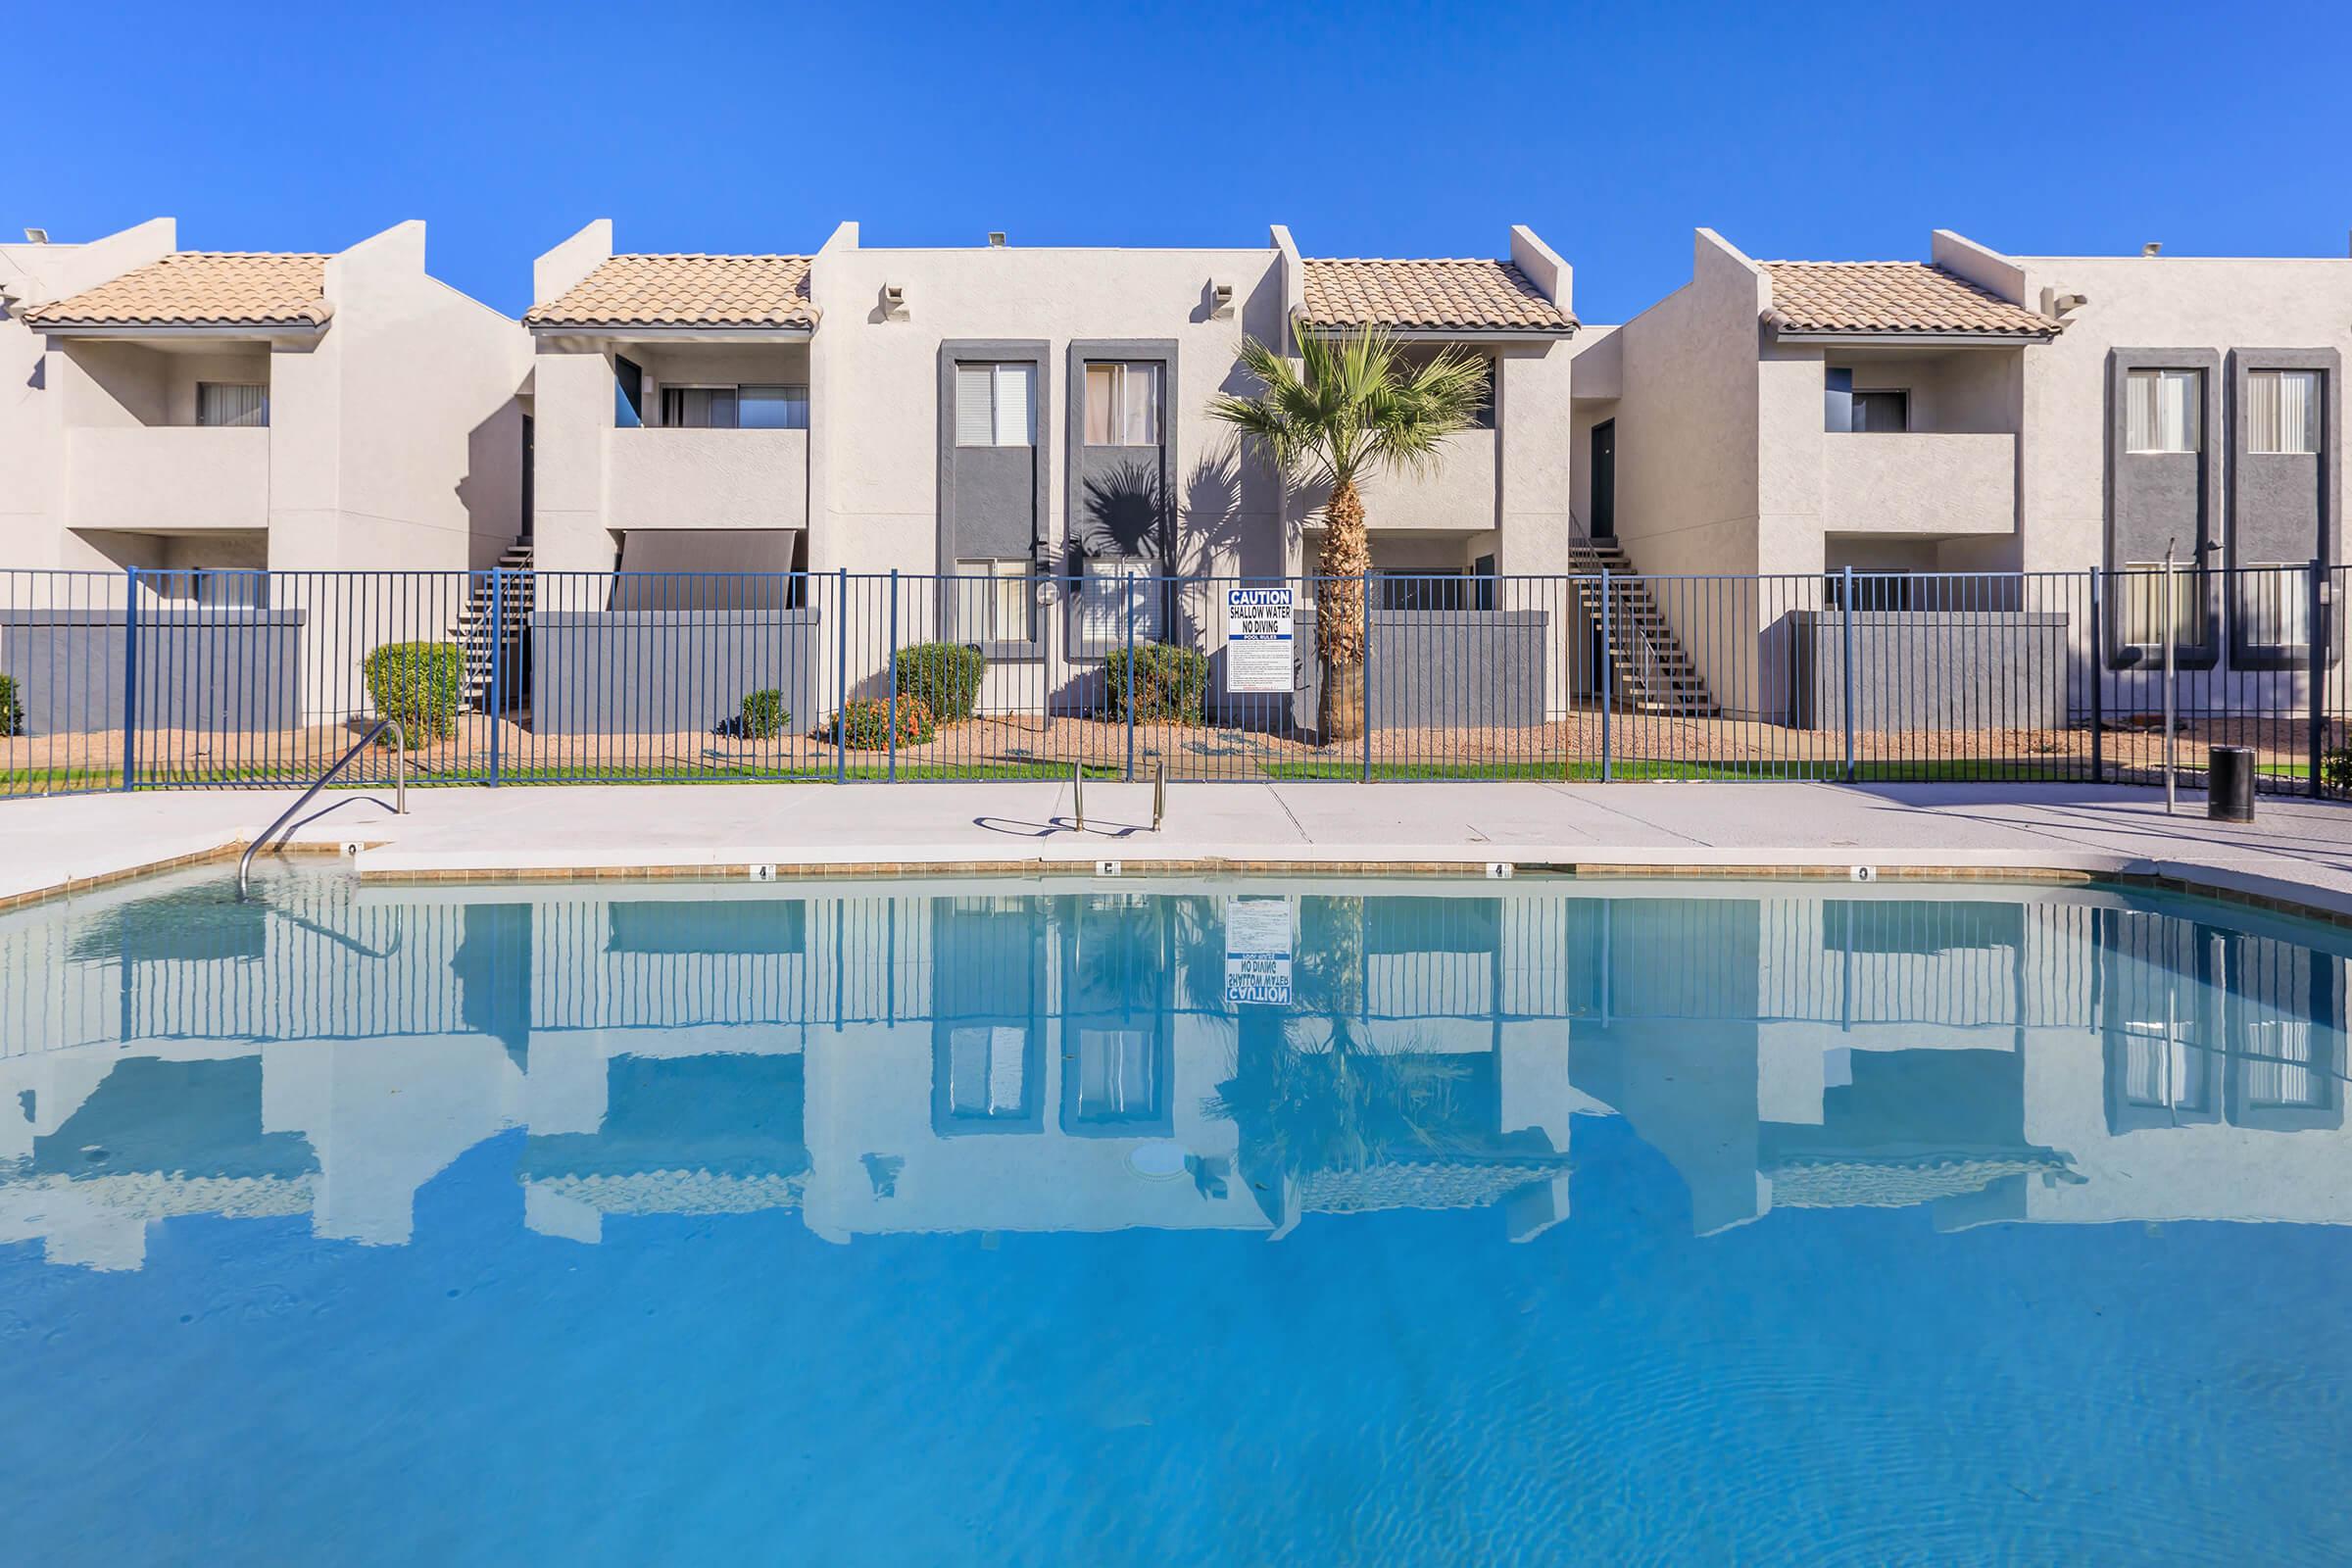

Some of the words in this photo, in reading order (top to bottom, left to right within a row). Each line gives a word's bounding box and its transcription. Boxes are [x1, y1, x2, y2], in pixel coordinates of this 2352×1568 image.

[1231, 591, 1290, 605] CAUTION
[1230, 607, 1264, 619] SHALLOW
[1266, 607, 1291, 619] WATER
[1243, 620, 1252, 633] NO
[1254, 620, 1278, 633] DIVING
